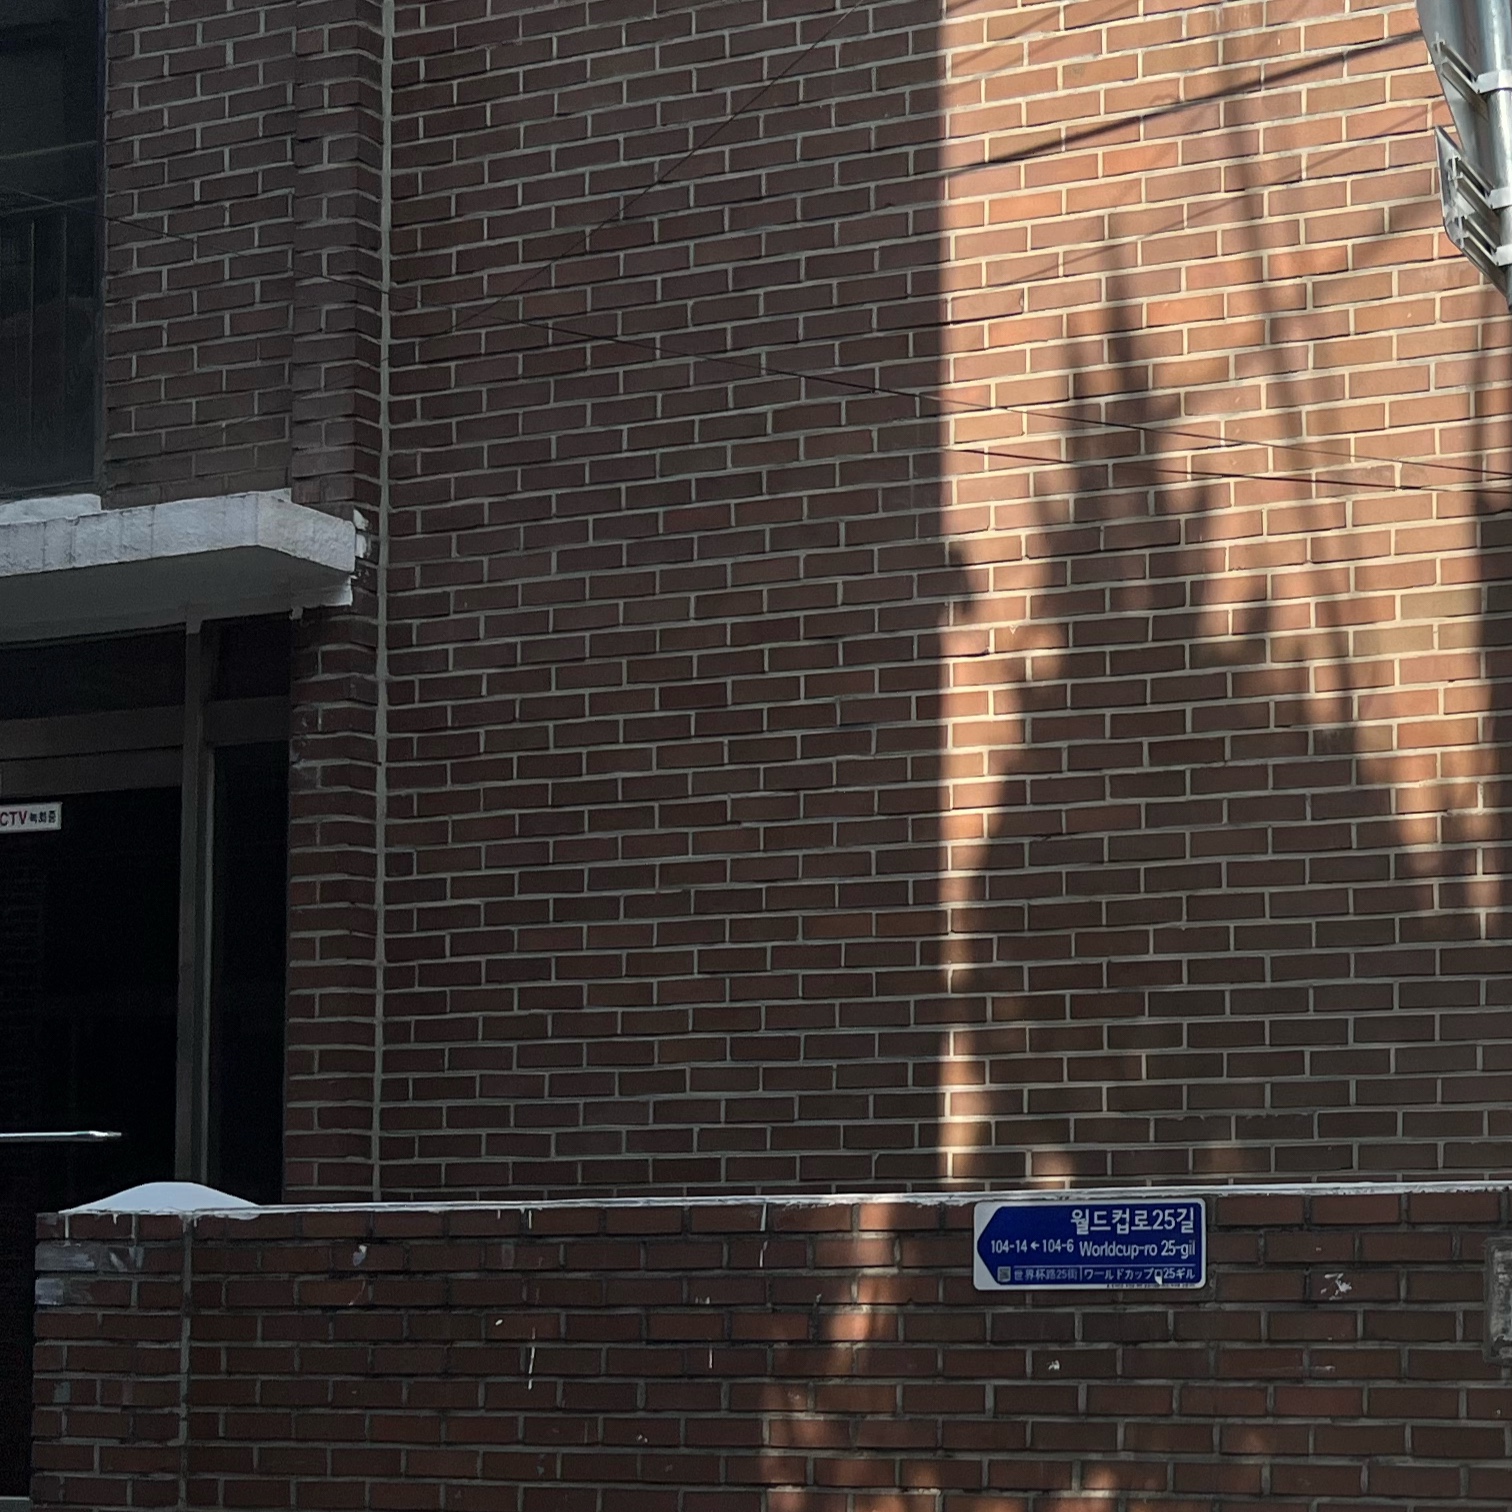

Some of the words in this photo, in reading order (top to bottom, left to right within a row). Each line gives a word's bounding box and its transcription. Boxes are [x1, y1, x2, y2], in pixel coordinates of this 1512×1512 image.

[1070, 1207, 1194, 1235] 월드컵로25길
[990, 1239, 1028, 1254] 104-14
[1042, 1238, 1075, 1253] 104-6
[1079, 1241, 1158, 1260] Worldcup-ro
[1161, 1240, 1196, 1260] 25-gil
